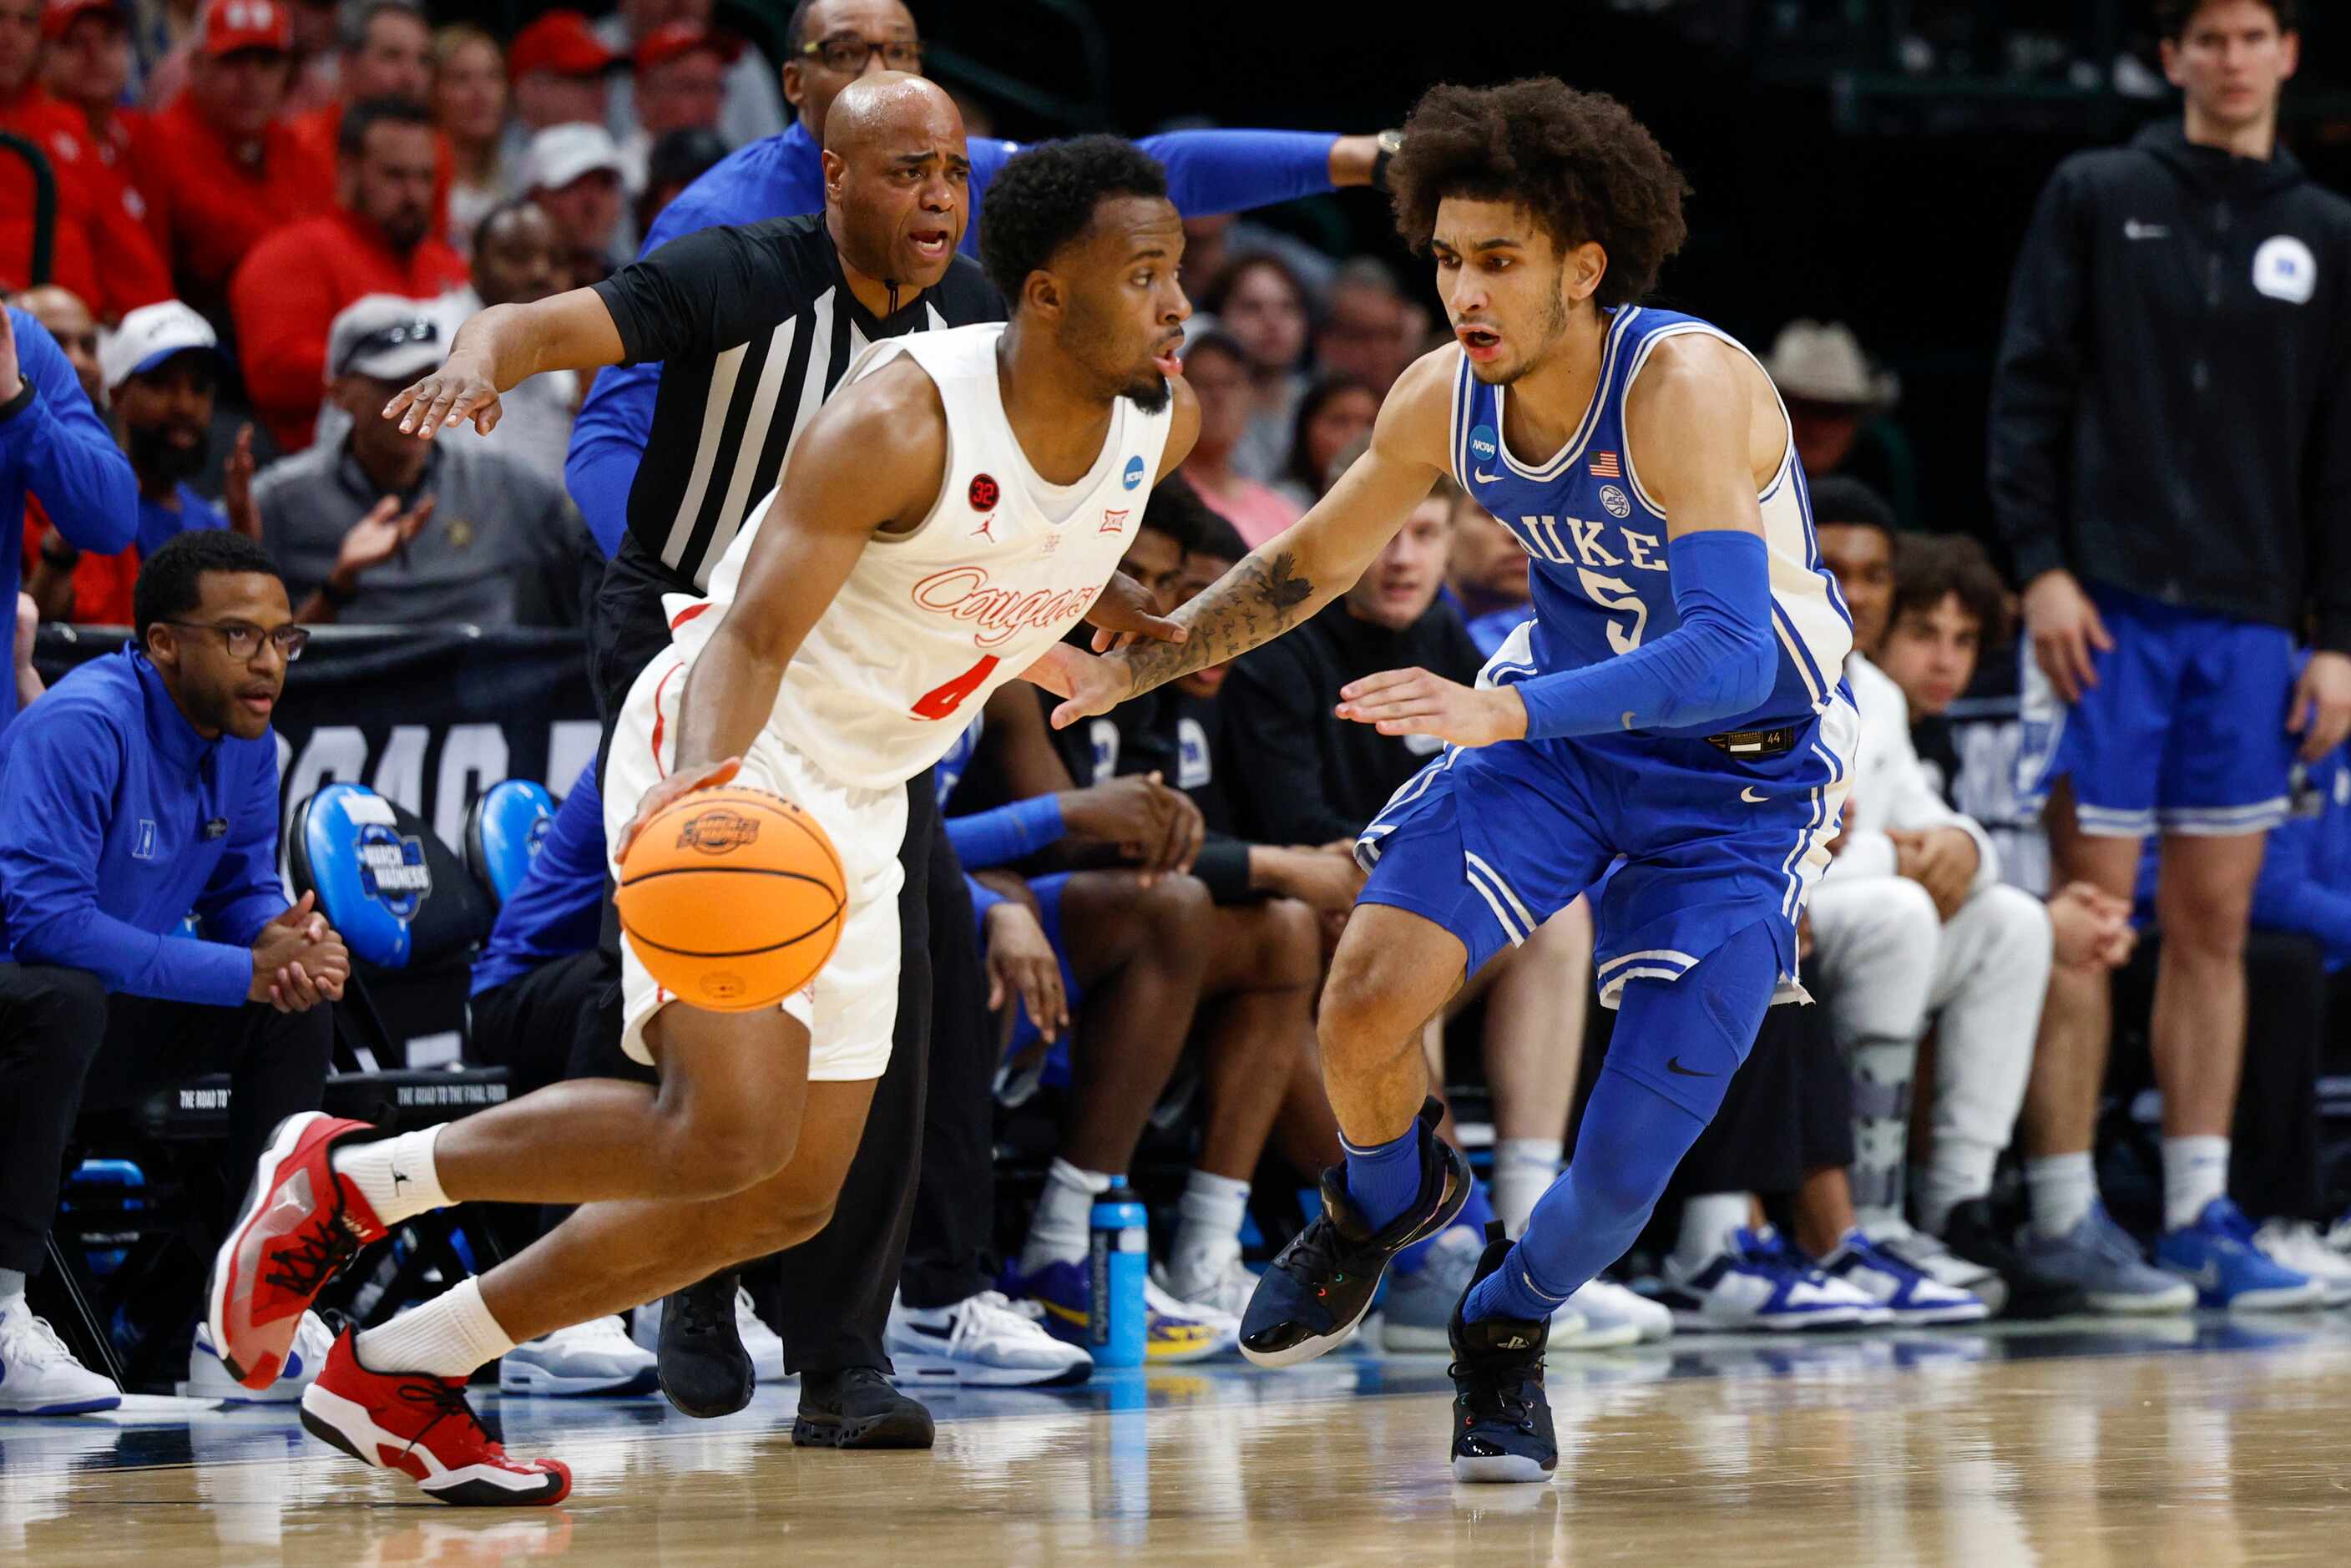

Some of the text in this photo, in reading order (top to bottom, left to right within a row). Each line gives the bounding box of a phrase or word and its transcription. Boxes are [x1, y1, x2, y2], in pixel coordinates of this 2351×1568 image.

[1472, 438, 1496, 455] NCAA
[972, 481, 994, 504] 32
[1605, 494, 1625, 506] ACC
[1576, 566, 1648, 655] 5
[1767, 731, 1781, 745] 44
[179, 1090, 195, 1109] THE
[195, 1090, 217, 1109] ROAD
[217, 1089, 228, 1108] TO
